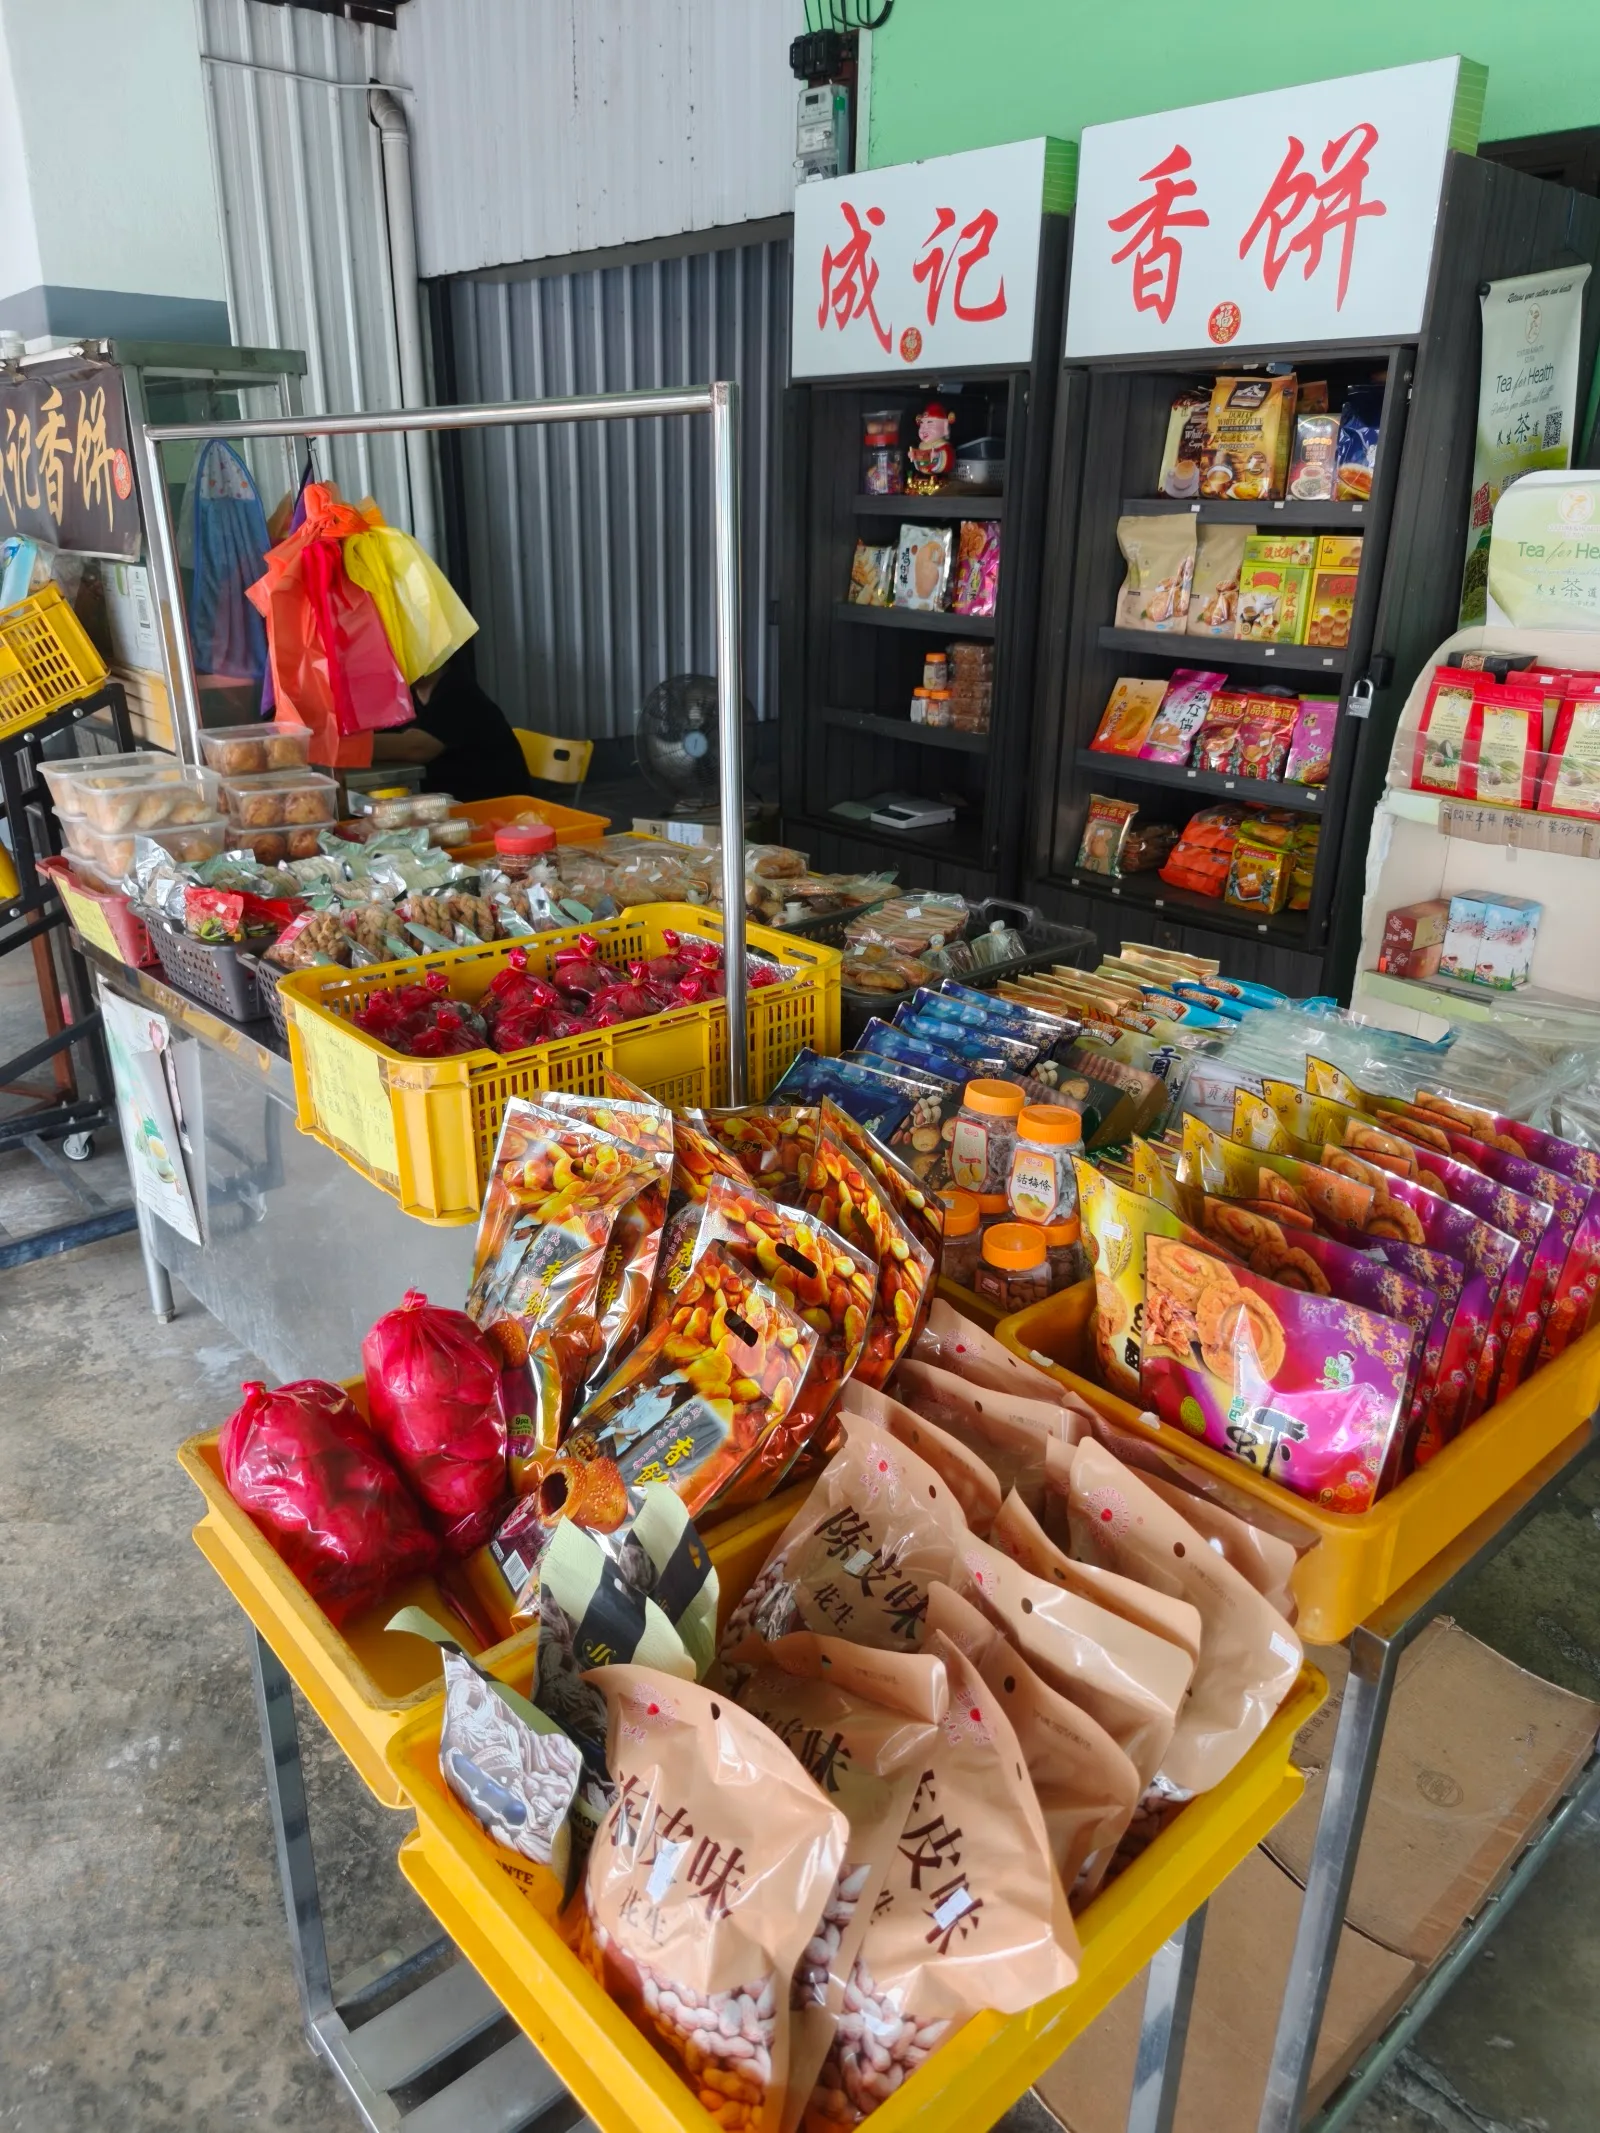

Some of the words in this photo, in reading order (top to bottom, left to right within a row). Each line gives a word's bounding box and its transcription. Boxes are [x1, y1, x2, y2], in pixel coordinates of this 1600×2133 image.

[1107, 121, 1388, 325] 香饼
[817, 201, 1007, 355] 成记
[1496, 374, 1512, 394] Tea
[1528, 362, 1554, 386] Health
[0, 386, 115, 533] 记香饼
[1518, 541, 1545, 558] Tea
[813, 1582, 854, 1632] 花生
